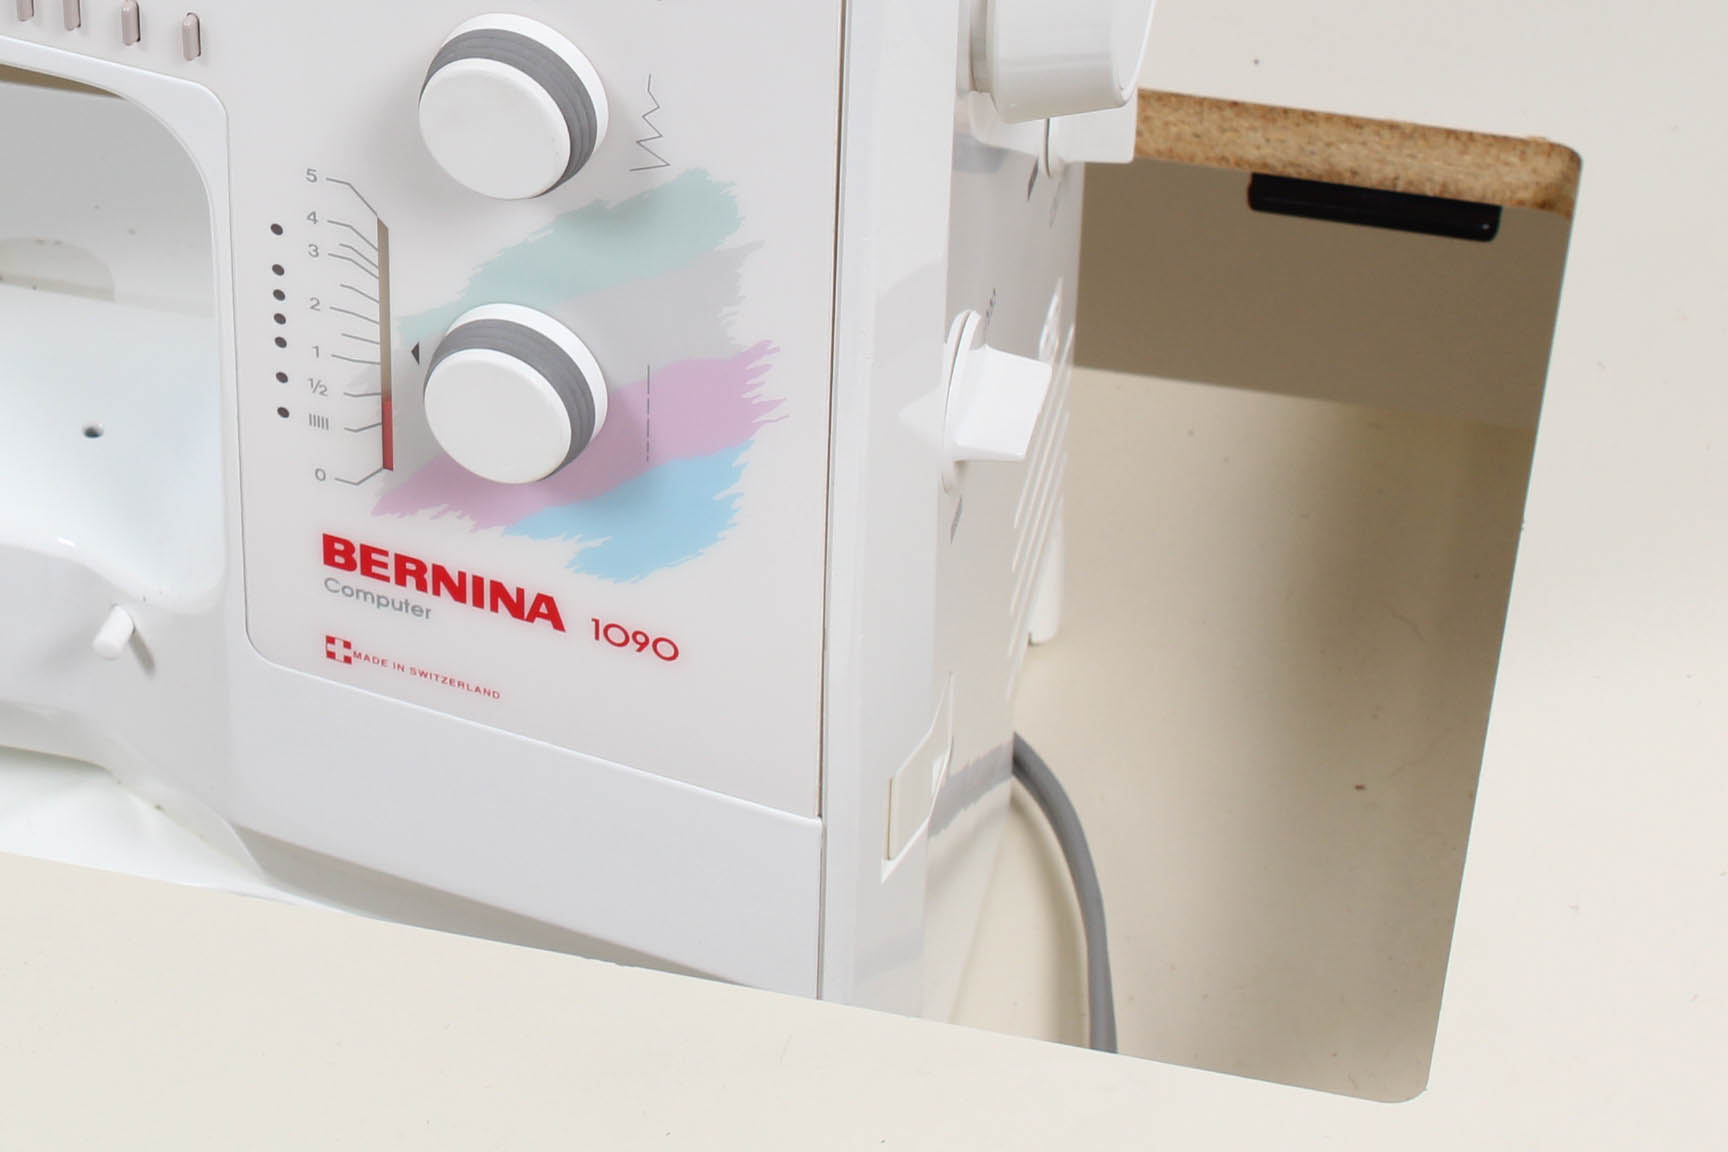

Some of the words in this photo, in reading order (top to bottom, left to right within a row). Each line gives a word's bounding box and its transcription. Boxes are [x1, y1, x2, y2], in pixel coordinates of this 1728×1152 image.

[305, 168, 318, 183] 5
[306, 211, 318, 225] 4
[308, 243, 319, 258] 3
[309, 297, 321, 312] 2
[322, 533, 566, 633] BERNINA
[323, 576, 432, 620] Computer
[591, 618, 680, 662] 1090
[352, 650, 389, 668] MADE
[393, 661, 405, 672] IN
[409, 666, 501, 700] SWITZERLAND
